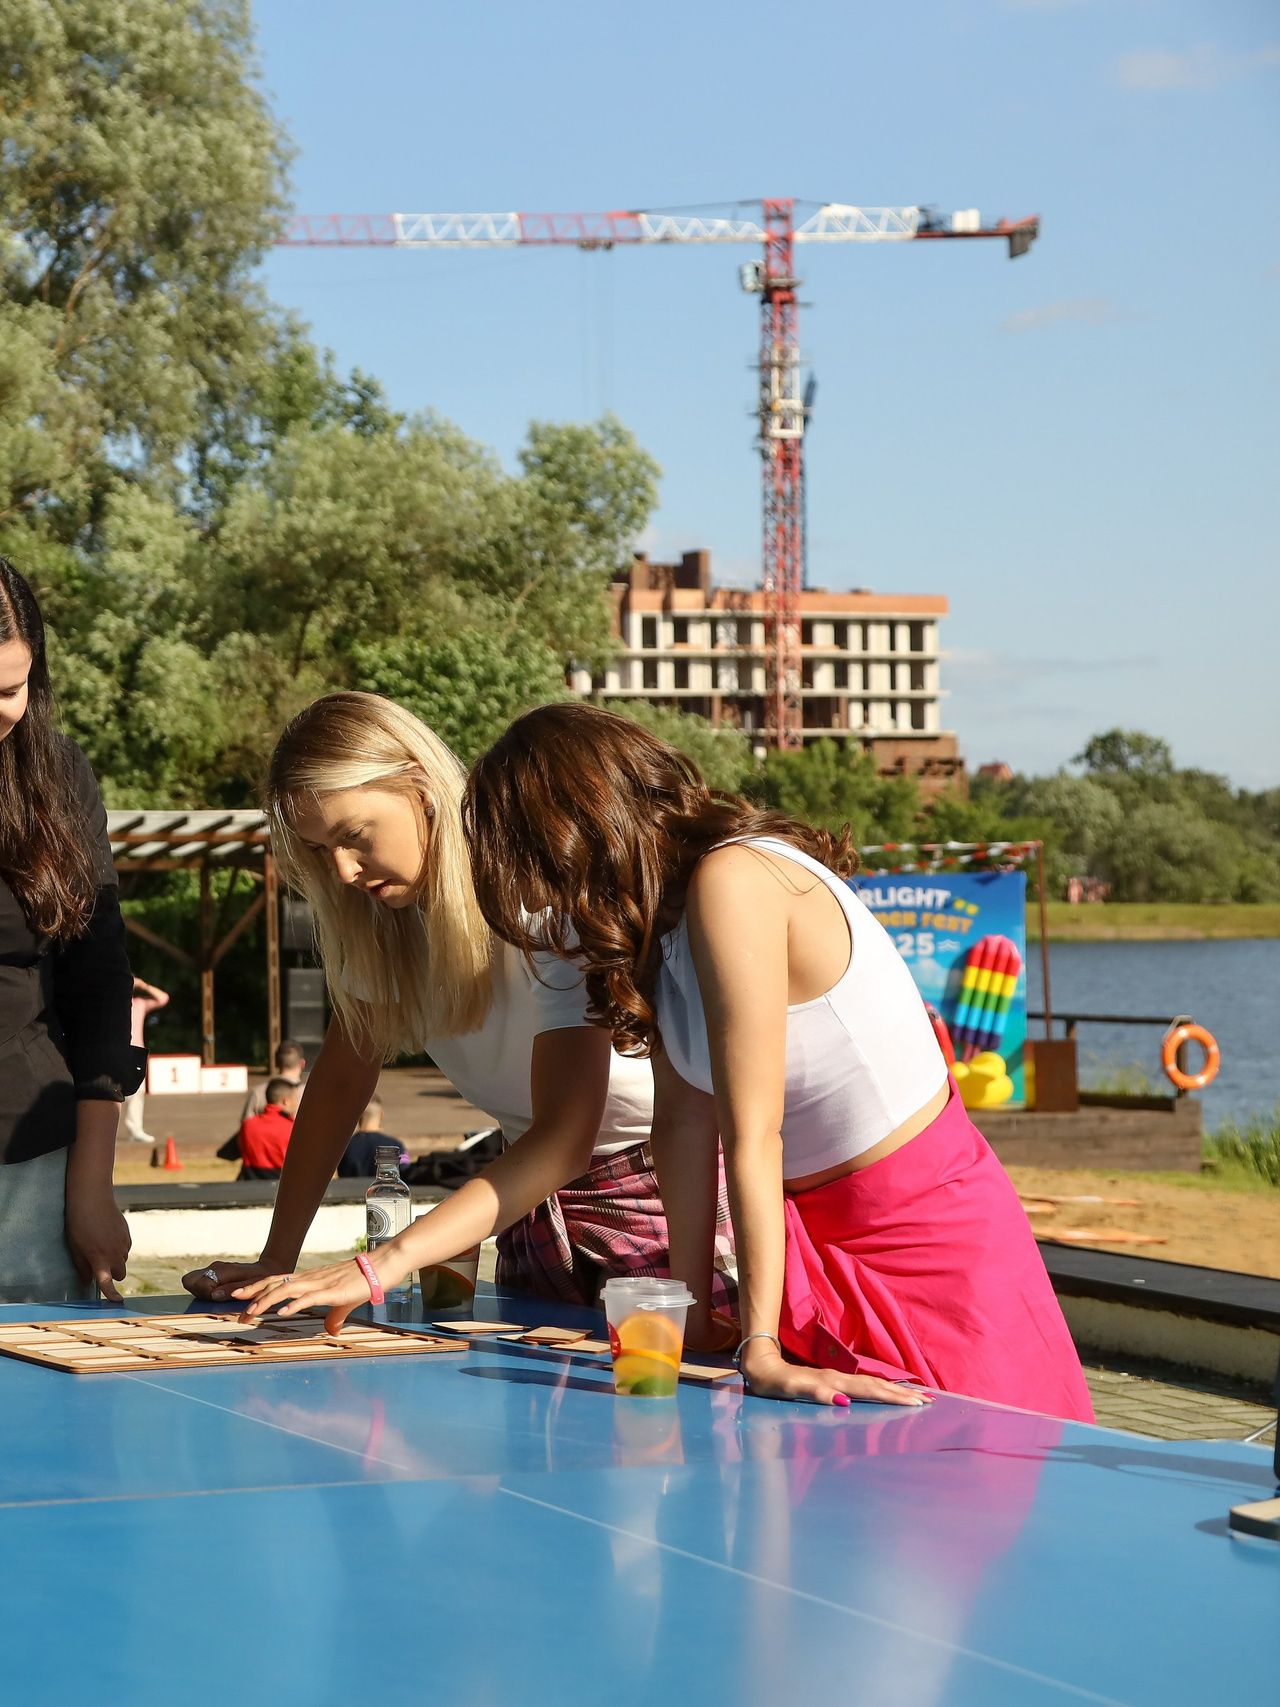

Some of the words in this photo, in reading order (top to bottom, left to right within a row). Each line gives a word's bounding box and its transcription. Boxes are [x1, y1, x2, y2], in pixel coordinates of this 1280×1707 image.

[857, 886, 951, 910] RLIGHT
[921, 912, 973, 934] FEST
[888, 933, 935, 957] 25
[171, 1066, 179, 1083] 1
[220, 1071, 229, 1086] 2
[364, 1264, 380, 1286] ДЕЛАЙ
